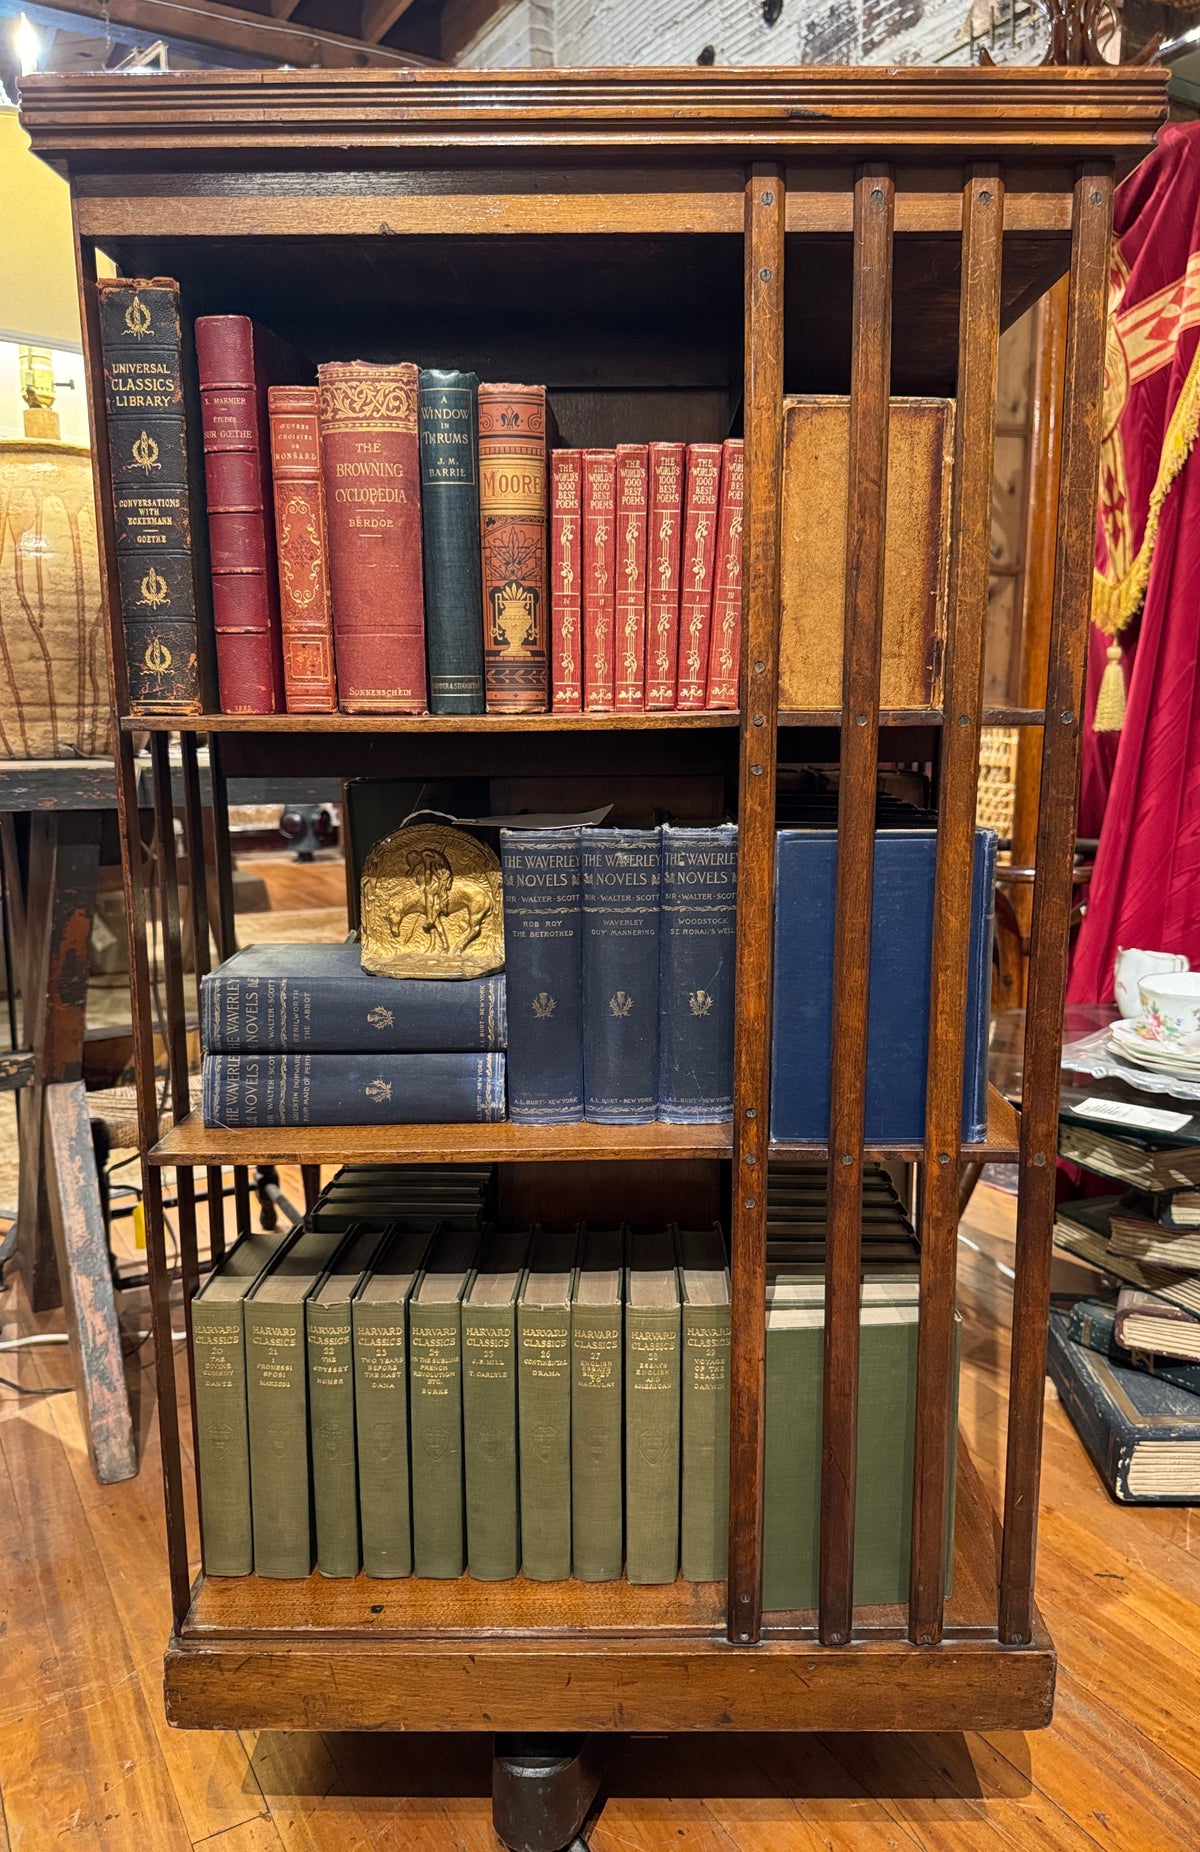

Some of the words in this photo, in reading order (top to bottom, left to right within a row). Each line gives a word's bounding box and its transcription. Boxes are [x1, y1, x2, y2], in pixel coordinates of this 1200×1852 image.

[112, 364, 170, 374] UNIVERSAL
[111, 379, 174, 392] CLASSICS
[116, 396, 171, 407] LIBRARY
[421, 407, 471, 420] WINDOW
[204, 430, 217, 439] SUR
[423, 432, 469, 445] THRUMS
[356, 443, 381, 453] THE
[276, 452, 316, 460] RONSARD
[625, 460, 640, 468] THE
[660, 457, 675, 466] THE
[698, 459, 712, 467] THE
[337, 463, 403, 477] BROWNING
[559, 464, 573, 472] THE
[593, 464, 608, 472] THE
[655, 466, 680, 475] WORLD'S
[692, 467, 717, 477] WORLD'S
[429, 469, 466, 477] BARRIE
[554, 472, 578, 481] WORLD'S
[589, 473, 613, 482] WORLD'S
[620, 469, 645, 477] WORLD'S
[484, 472, 541, 496] MOORE
[624, 478, 641, 486] 1000
[659, 476, 676, 484] 1000
[593, 483, 609, 491] 1000
[624, 487, 642, 495] BEST
[659, 485, 676, 493] BEST
[696, 486, 713, 494] BEST
[593, 492, 610, 500] BEST
[622, 496, 645, 505] POEMS
[657, 494, 679, 502] POEMS
[693, 495, 715, 504] POEMS
[119, 499, 180, 508] CONVERSATIONS
[556, 500, 578, 508] POEMS
[591, 501, 613, 509] POEMS
[139, 508, 159, 516] WITH
[127, 517, 172, 526] ECKERMANN
[349, 519, 393, 527] BERDOE
[504, 856, 521, 868] THE
[526, 856, 580, 868] WAVERLEY
[584, 854, 601, 867] THE
[605, 854, 660, 868] WAVERLEY
[666, 853, 685, 867] THE
[517, 874, 567, 887] NOVELS
[597, 873, 646, 885] NOVELS
[677, 872, 727, 884] NOVELS
[521, 895, 553, 903] WALTER
[600, 894, 632, 902] WALTER
[681, 893, 711, 901] WALTER
[523, 920, 539, 928] ROB
[227, 978, 239, 1034] WAVERLEY
[246, 992, 259, 1043] NOVELS
[245, 1063, 258, 1113] NOVELS
[267, 1079, 275, 1110] WALTER
[195, 1326, 240, 1334] HARVARD
[253, 1326, 296, 1336] HARVARD
[309, 1326, 350, 1335] HARVARD
[358, 1327, 402, 1336] HARVARD
[412, 1327, 456, 1336] HARVARD
[466, 1328, 511, 1337] HARVARD
[523, 1329, 567, 1337] HARVARD
[574, 1329, 618, 1339] HARVARD
[688, 1328, 731, 1337] HARVARD
[195, 1336, 239, 1344] CLASSICS
[309, 1336, 349, 1345] CLASSICS
[632, 1332, 676, 1340] HARVARD
[253, 1337, 296, 1346] CLASSICS
[358, 1338, 402, 1346] CLASSICS
[413, 1338, 455, 1346] CLASSICS
[467, 1339, 510, 1347] CLASSICS
[524, 1339, 567, 1348] CLASSICS
[575, 1340, 618, 1349] CLASSICS
[688, 1339, 731, 1347] CLASSICS
[632, 1342, 675, 1351] CLASSICS
